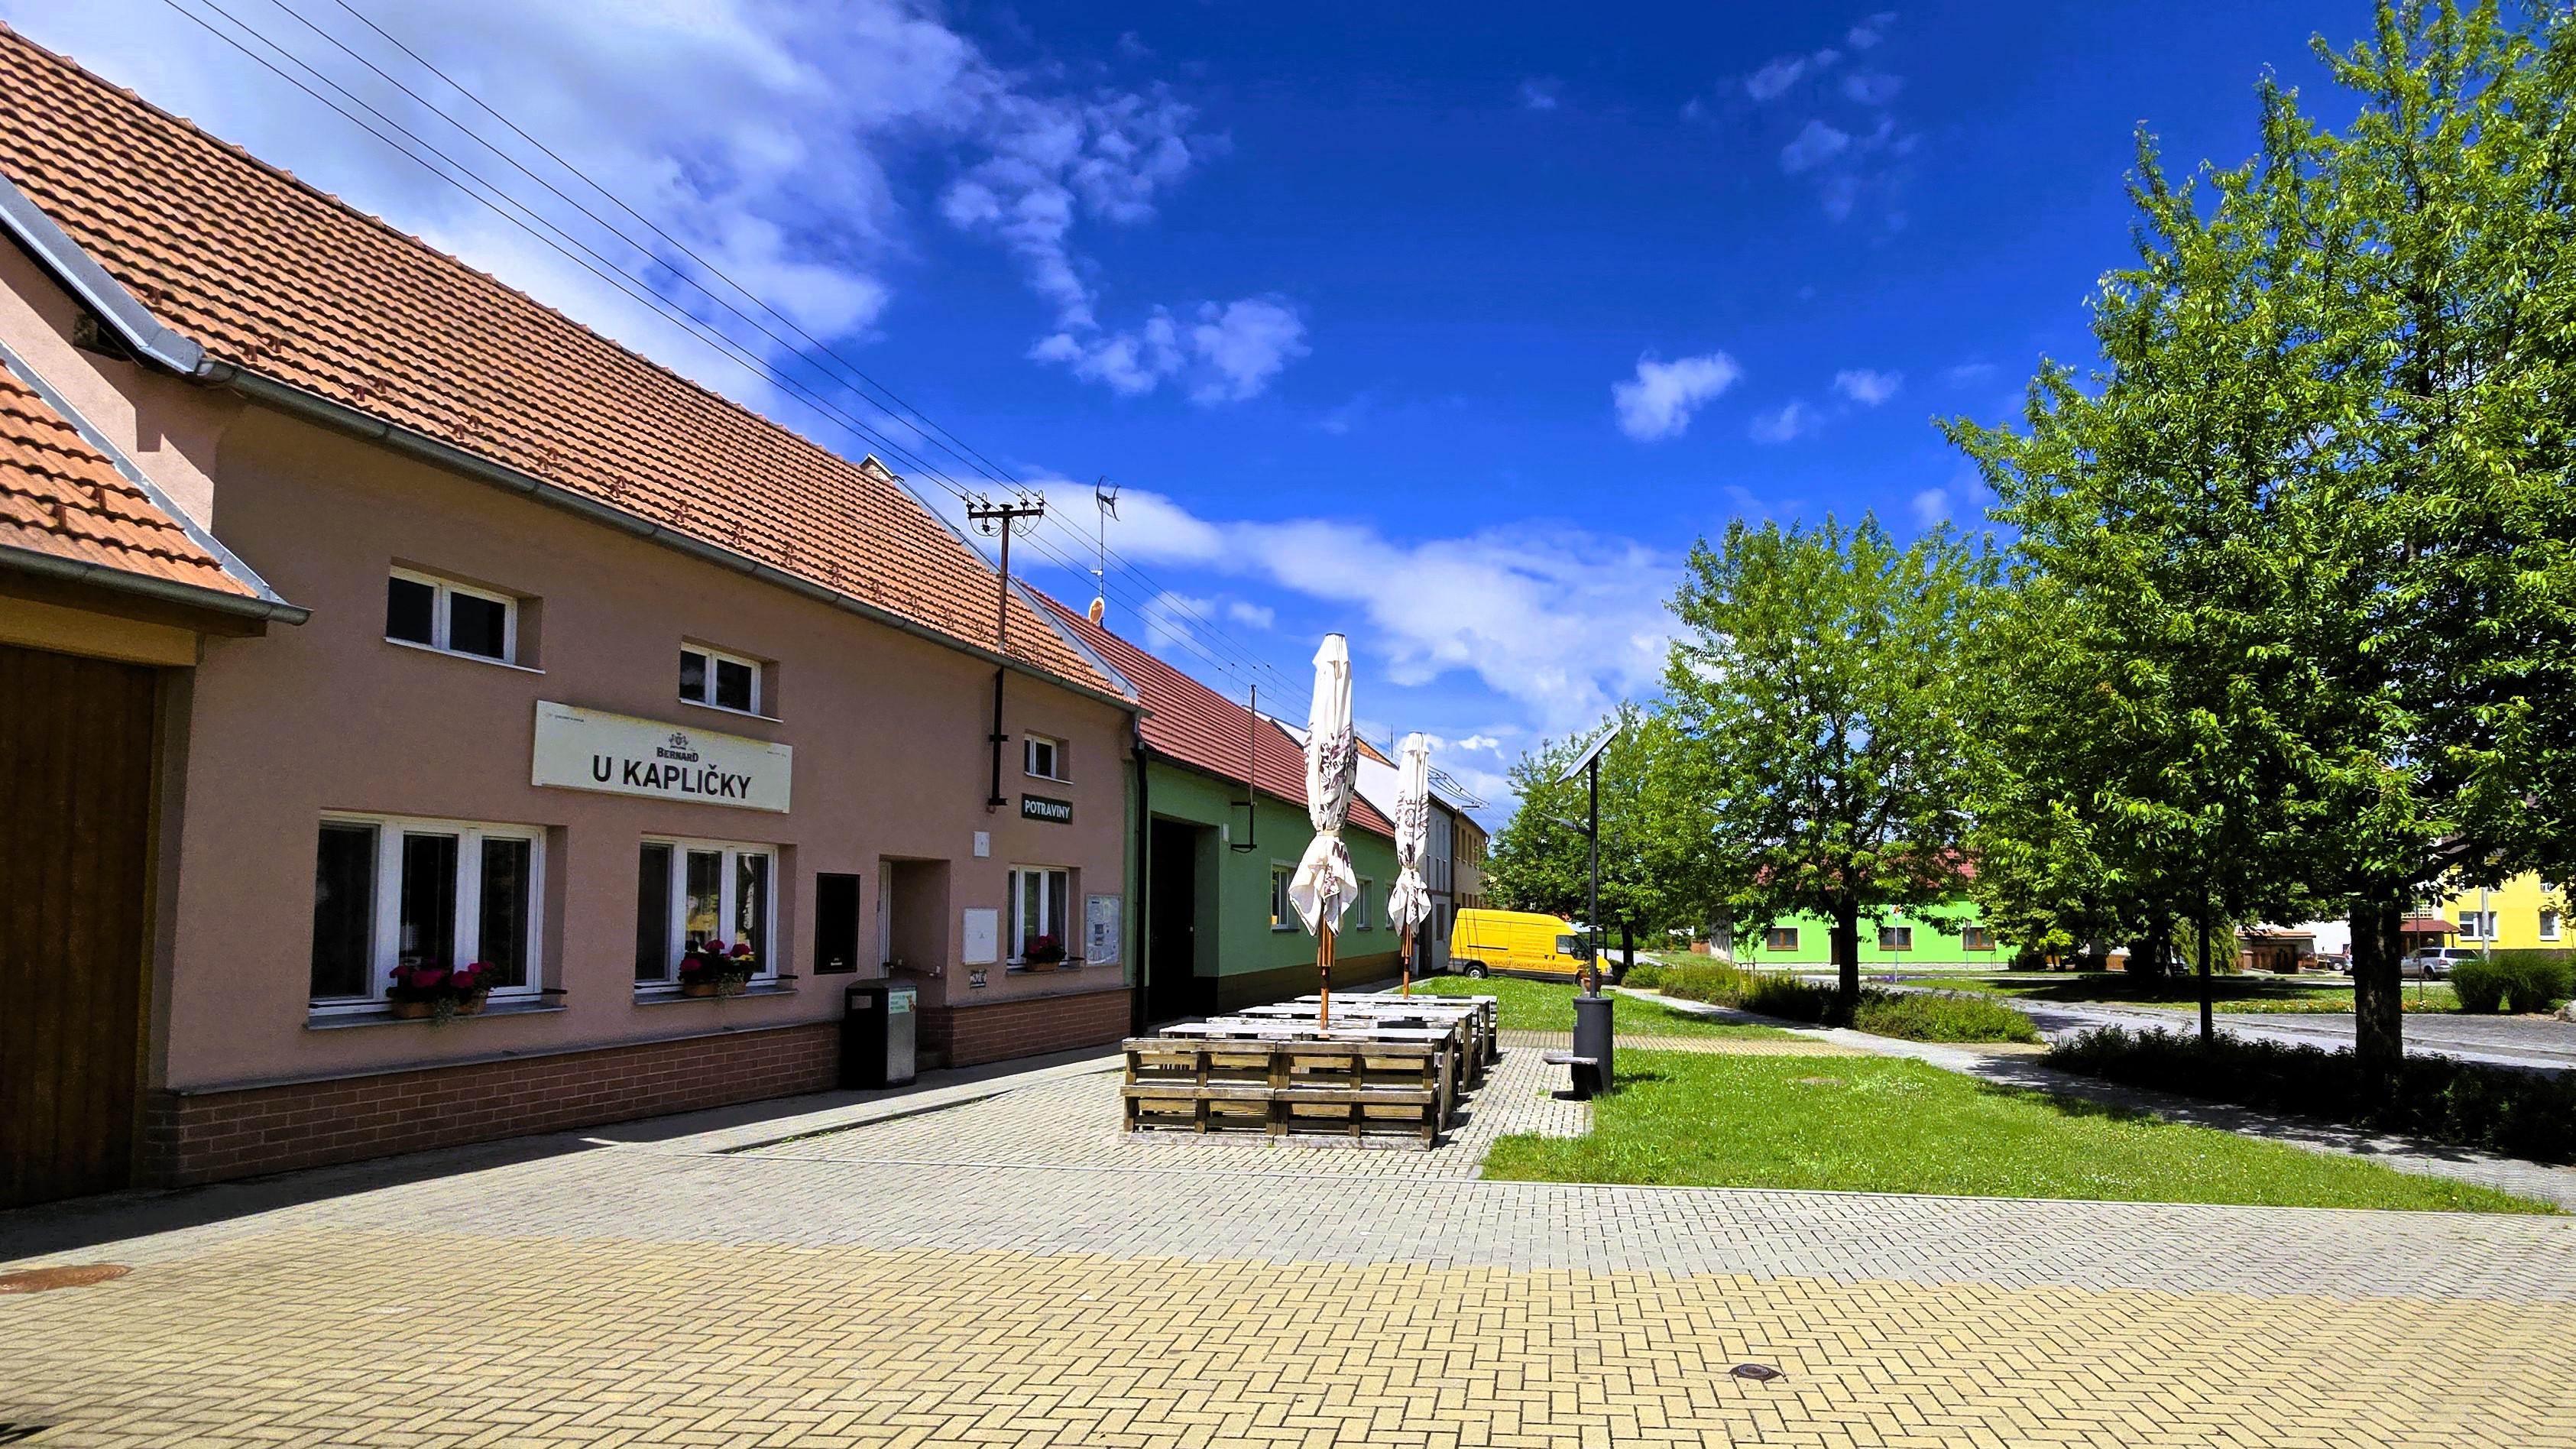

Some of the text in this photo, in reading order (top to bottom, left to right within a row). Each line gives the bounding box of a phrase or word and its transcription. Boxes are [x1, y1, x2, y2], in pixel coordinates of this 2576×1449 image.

[656, 747, 699, 762] BERNARD
[593, 755, 752, 799] U KAPLIČKY
[1024, 799, 1071, 819] POTRAVINY
